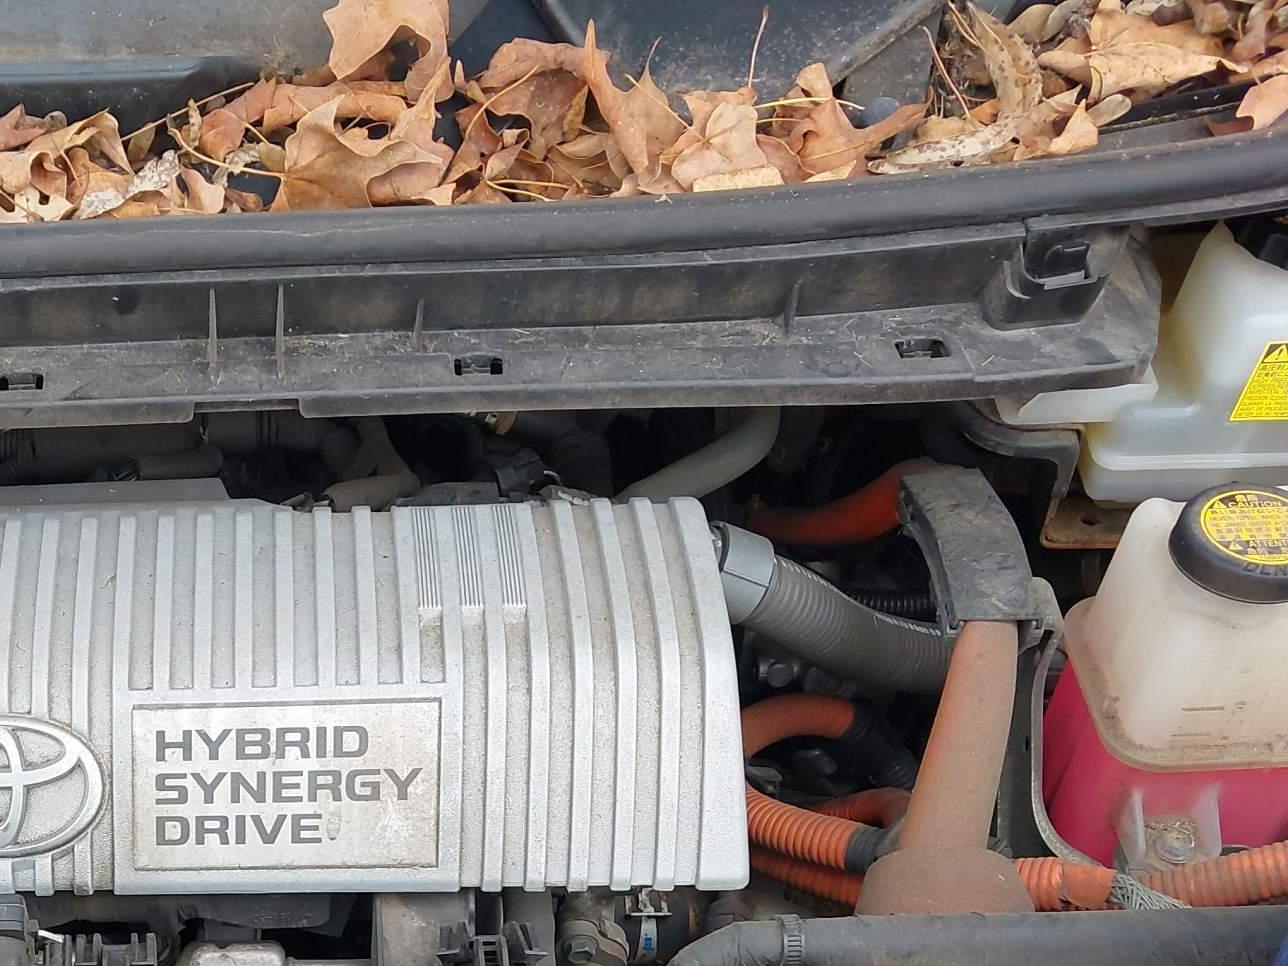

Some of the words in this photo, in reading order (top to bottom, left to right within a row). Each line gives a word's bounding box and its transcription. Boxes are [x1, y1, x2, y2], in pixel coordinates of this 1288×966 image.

[1228, 501, 1282, 509] CAUTION
[155, 725, 369, 762] HYBRID
[155, 767, 424, 805] SYNERGY
[155, 813, 323, 846] DRIVE
